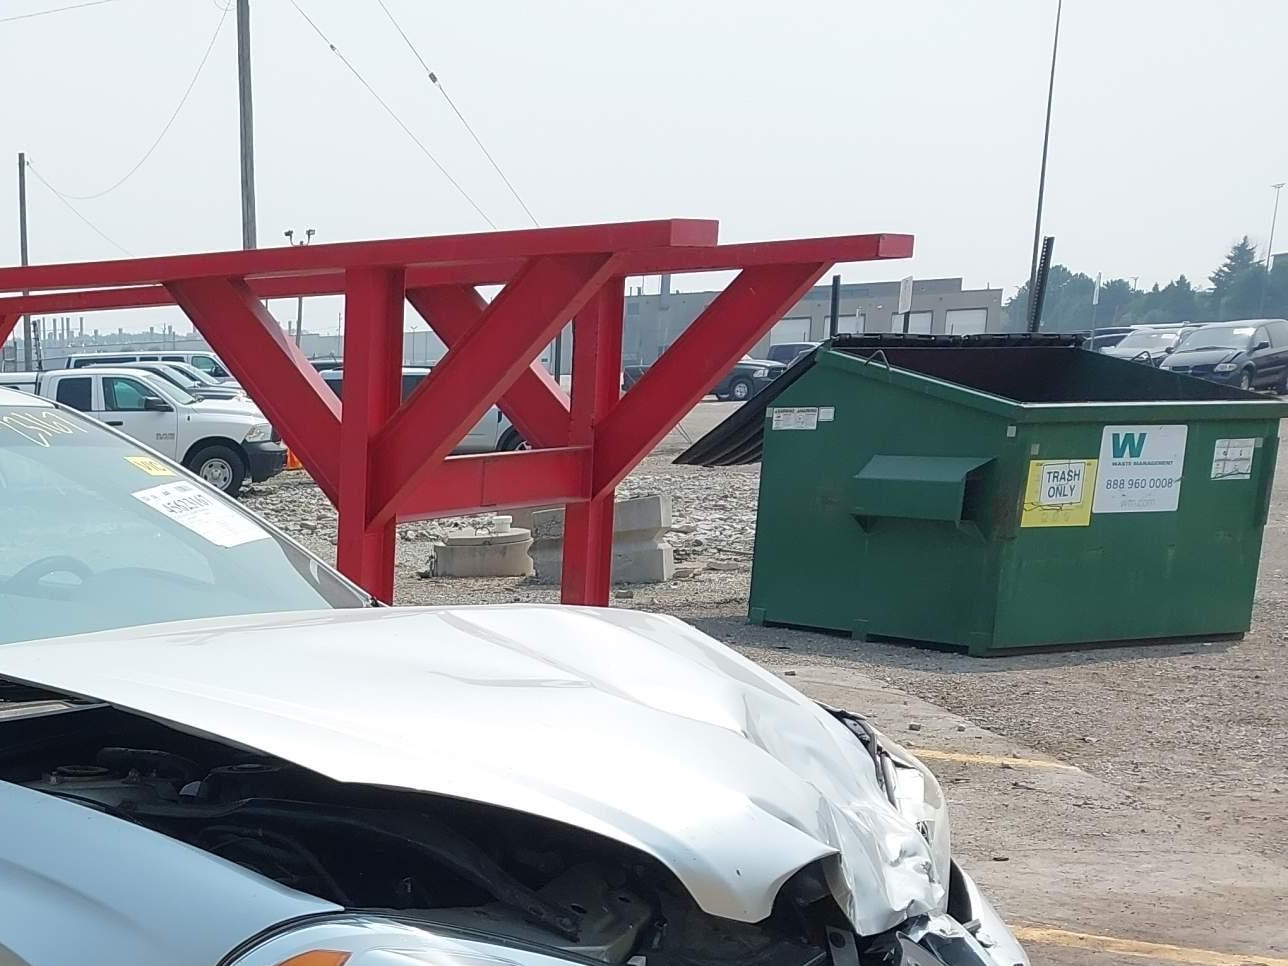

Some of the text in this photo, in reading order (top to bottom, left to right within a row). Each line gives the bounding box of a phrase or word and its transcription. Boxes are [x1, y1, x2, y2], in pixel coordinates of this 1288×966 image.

[1112, 432, 1147, 459] W
[1047, 470, 1081, 483] TRASH
[1105, 478, 1173, 489] 888 960 0008
[1047, 485, 1075, 498] ONLY
